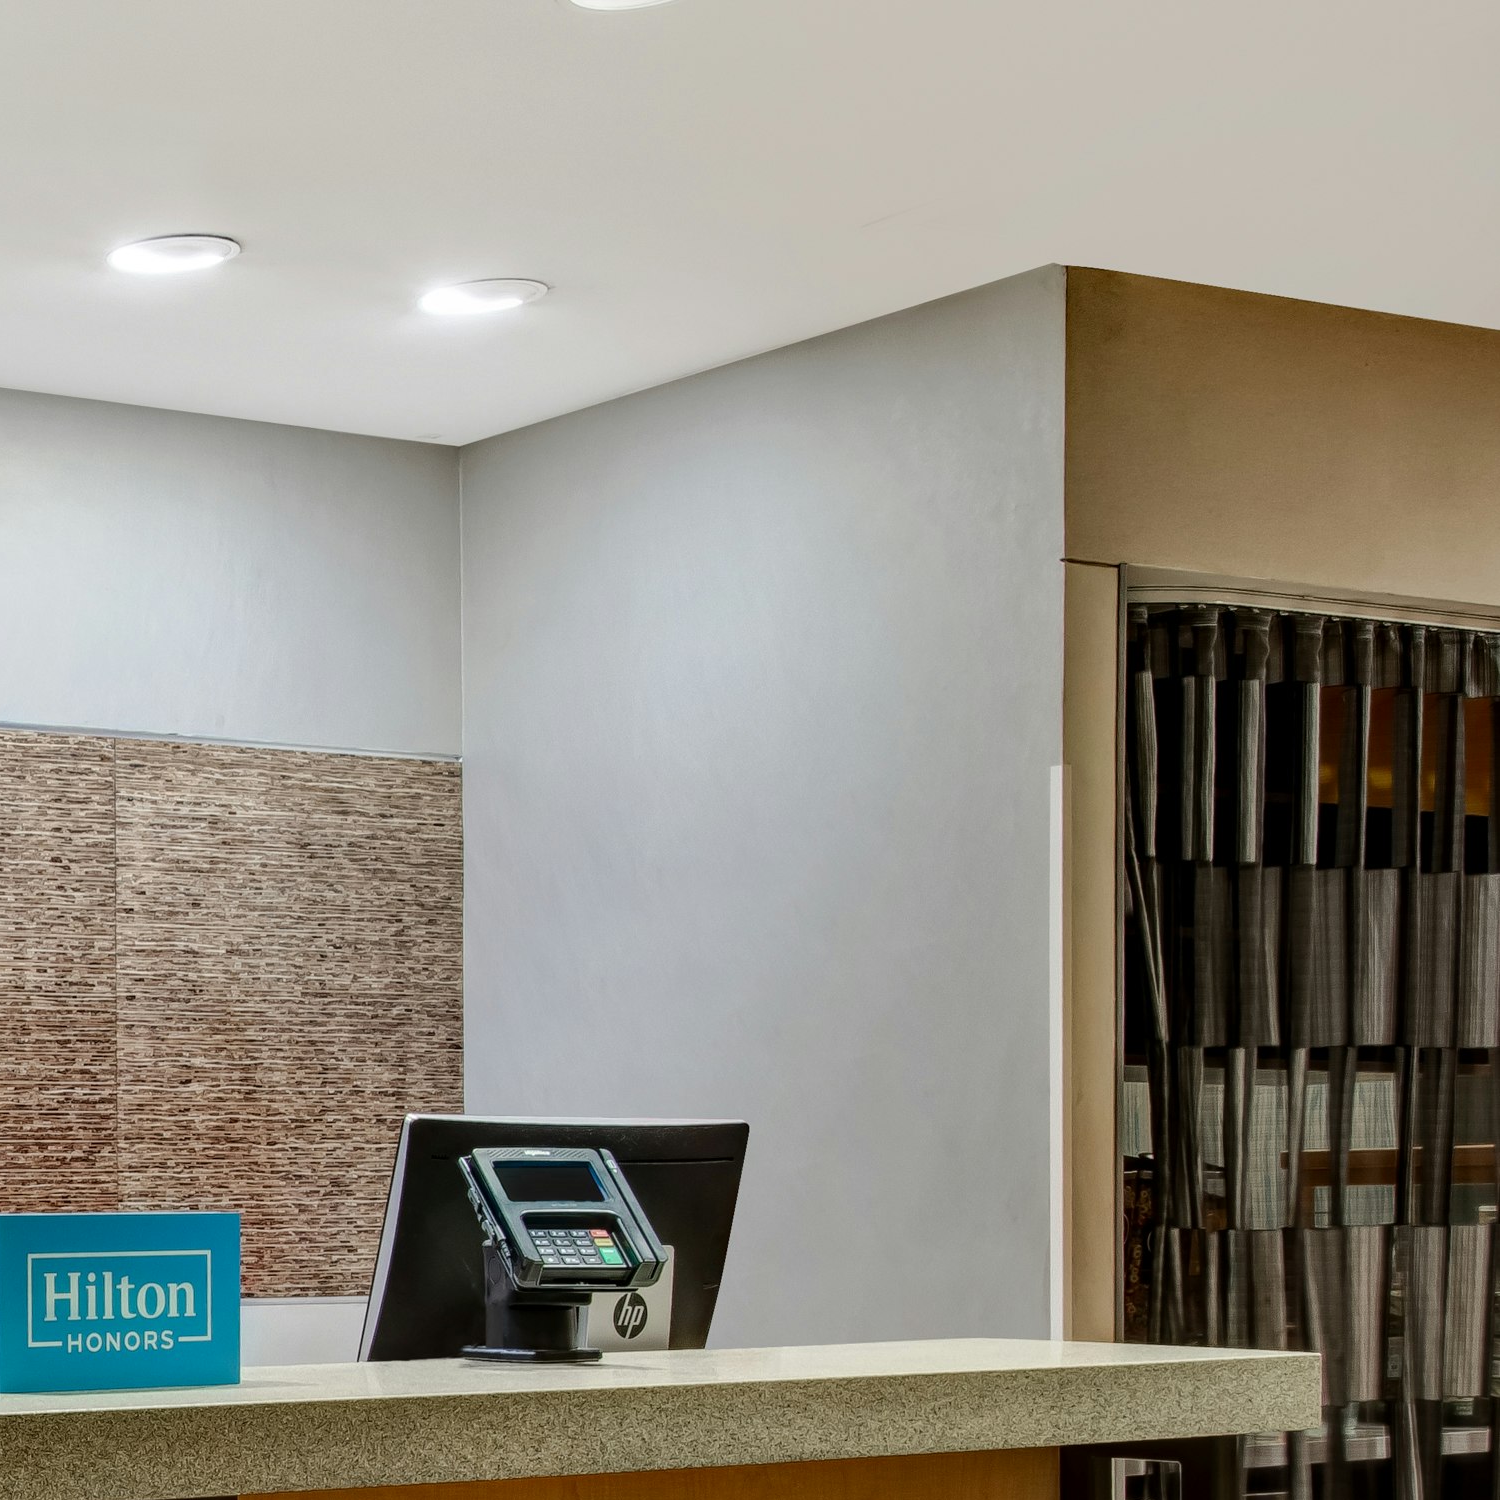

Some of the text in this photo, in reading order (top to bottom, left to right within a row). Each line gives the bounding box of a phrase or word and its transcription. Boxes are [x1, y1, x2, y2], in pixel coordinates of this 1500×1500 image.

[43, 1271, 197, 1322] Hilton
[617, 1292, 645, 1339] hp
[66, 1329, 175, 1354] HONORS
